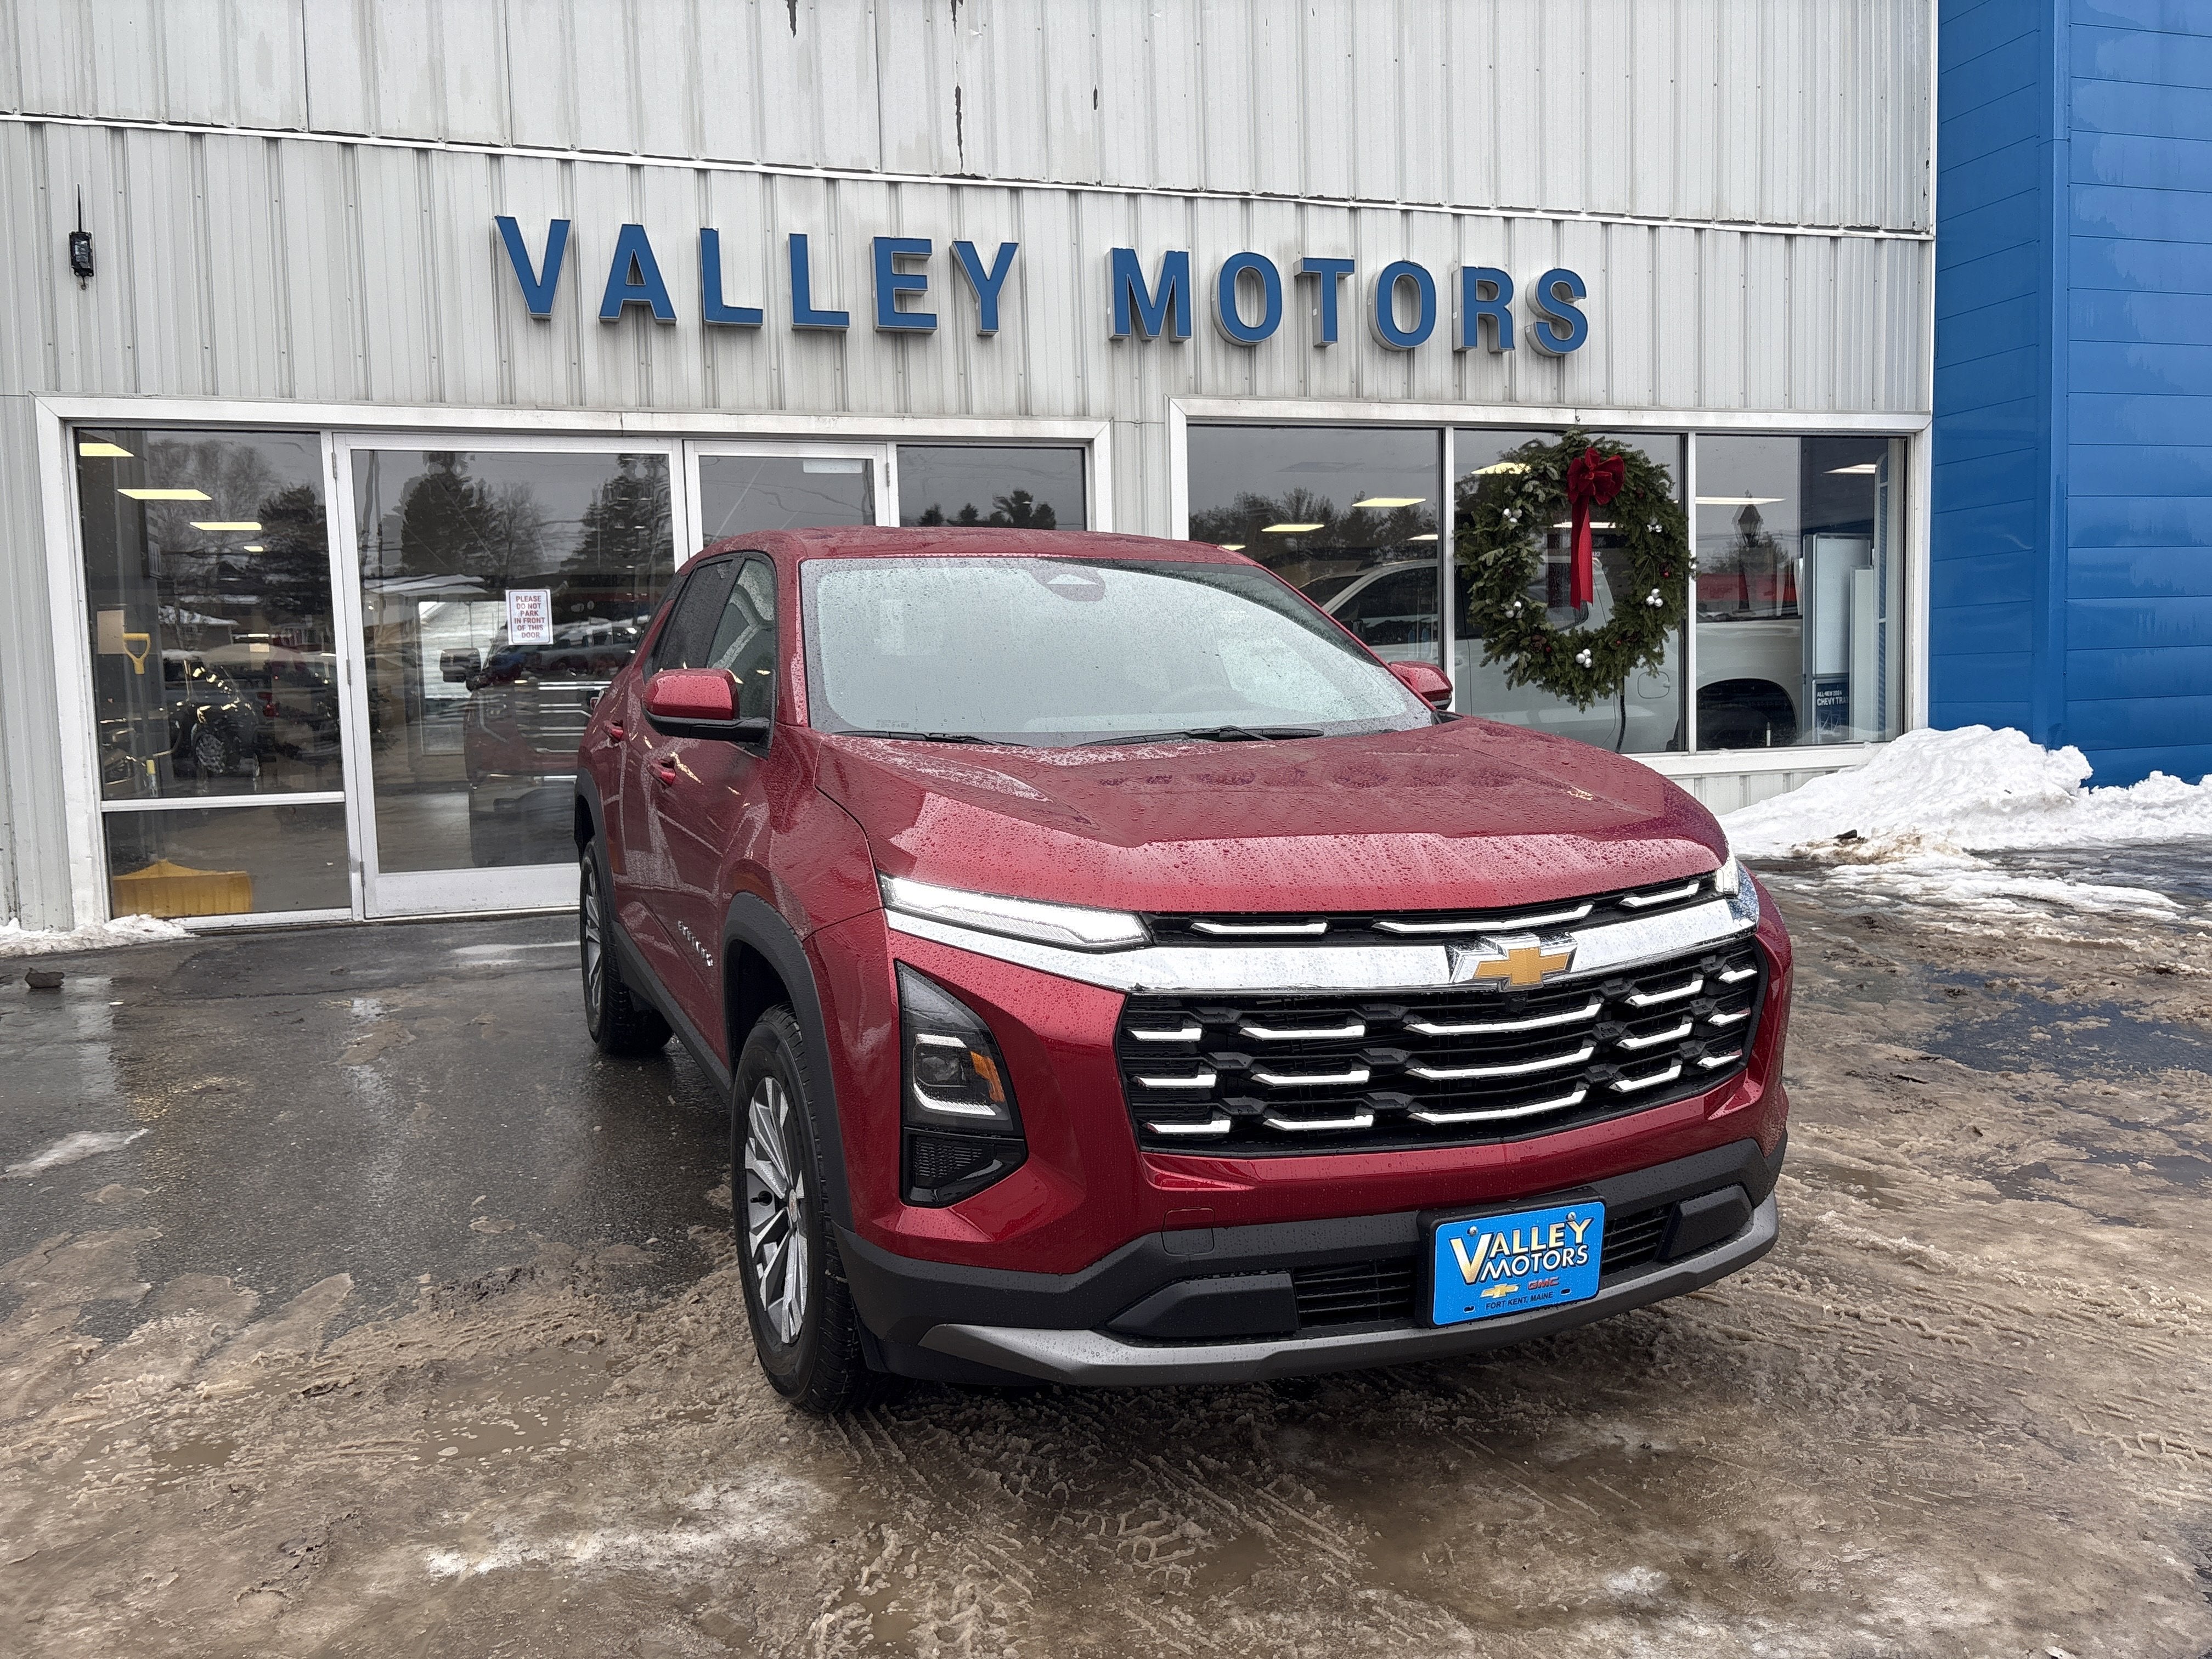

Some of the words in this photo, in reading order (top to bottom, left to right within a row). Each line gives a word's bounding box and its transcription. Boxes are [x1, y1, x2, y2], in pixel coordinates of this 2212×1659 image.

[495, 215, 1019, 337] VALLEY
[1104, 247, 1589, 358] MOTORS
[1816, 697, 1835, 706] CHEVY
[1449, 1217, 1594, 1285] VALLEY
[1480, 1244, 1589, 1282] MOTORS
[1528, 1277, 1560, 1290] GMC
[1485, 1300, 1507, 1310] FORT
[1508, 1296, 1528, 1306] KENT,
[1530, 1291, 1554, 1302] MAINE
